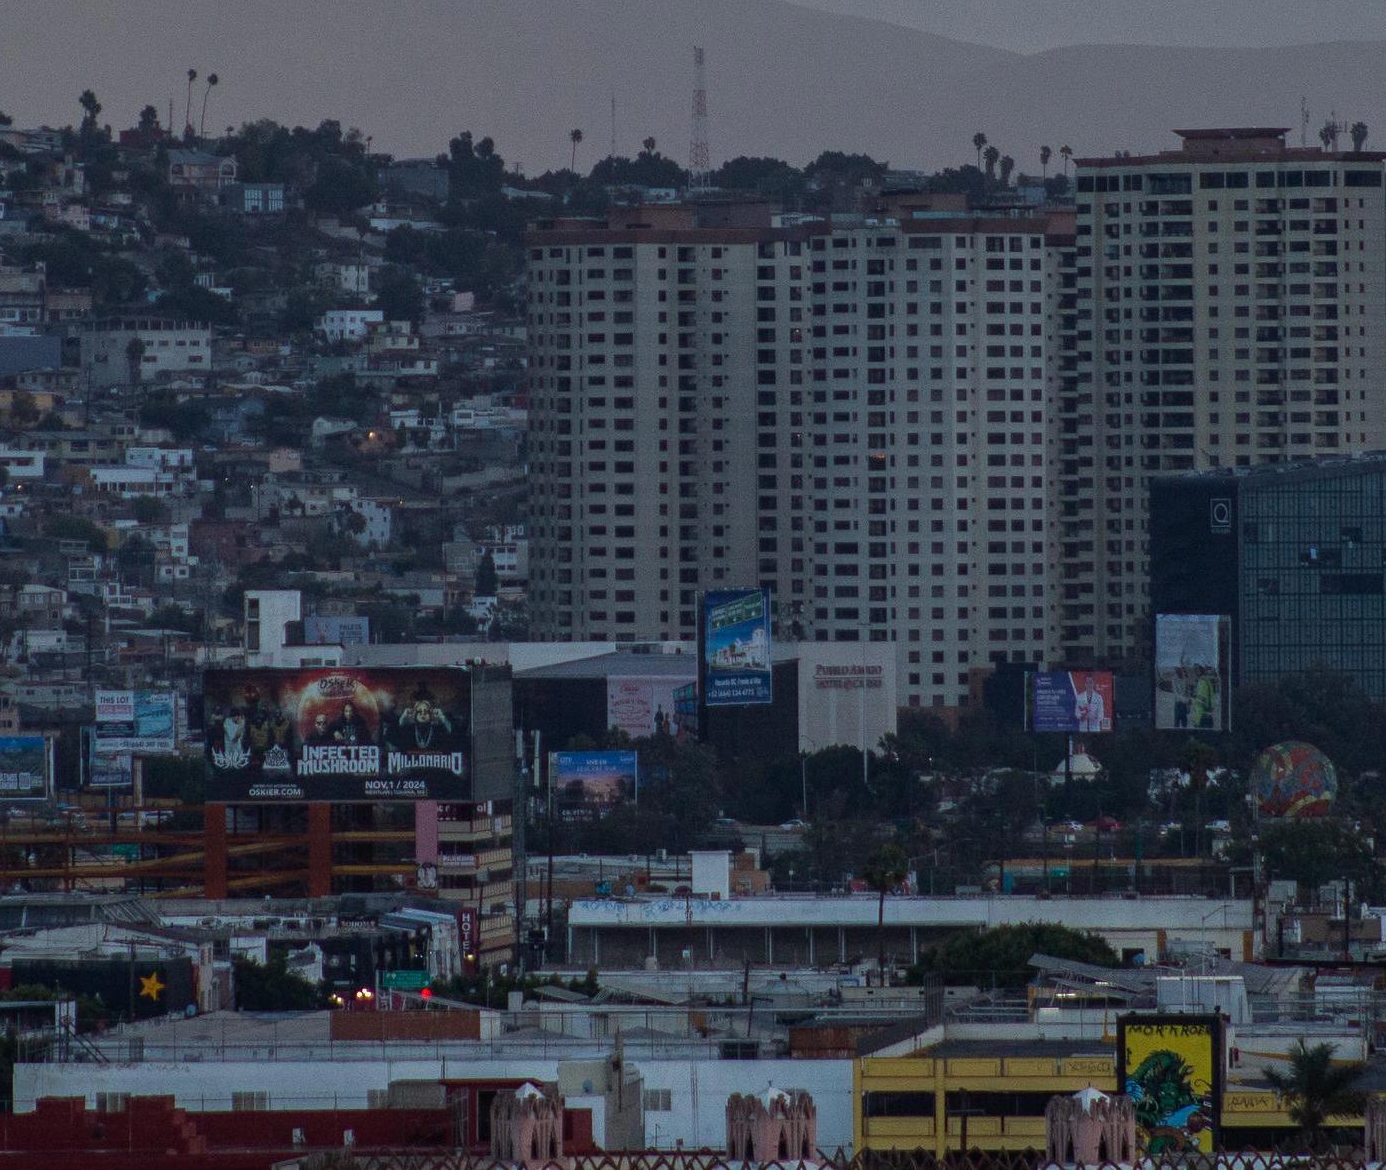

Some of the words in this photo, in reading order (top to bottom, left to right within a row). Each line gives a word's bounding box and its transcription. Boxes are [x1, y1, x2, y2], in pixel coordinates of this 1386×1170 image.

[303, 745, 380, 760] INFECTED
[297, 759, 380, 776] MUSHROOM
[387, 751, 464, 775] MILLONARIO
[403, 780, 426, 789] 2024
[248, 787, 302, 798] OSKIER.COM
